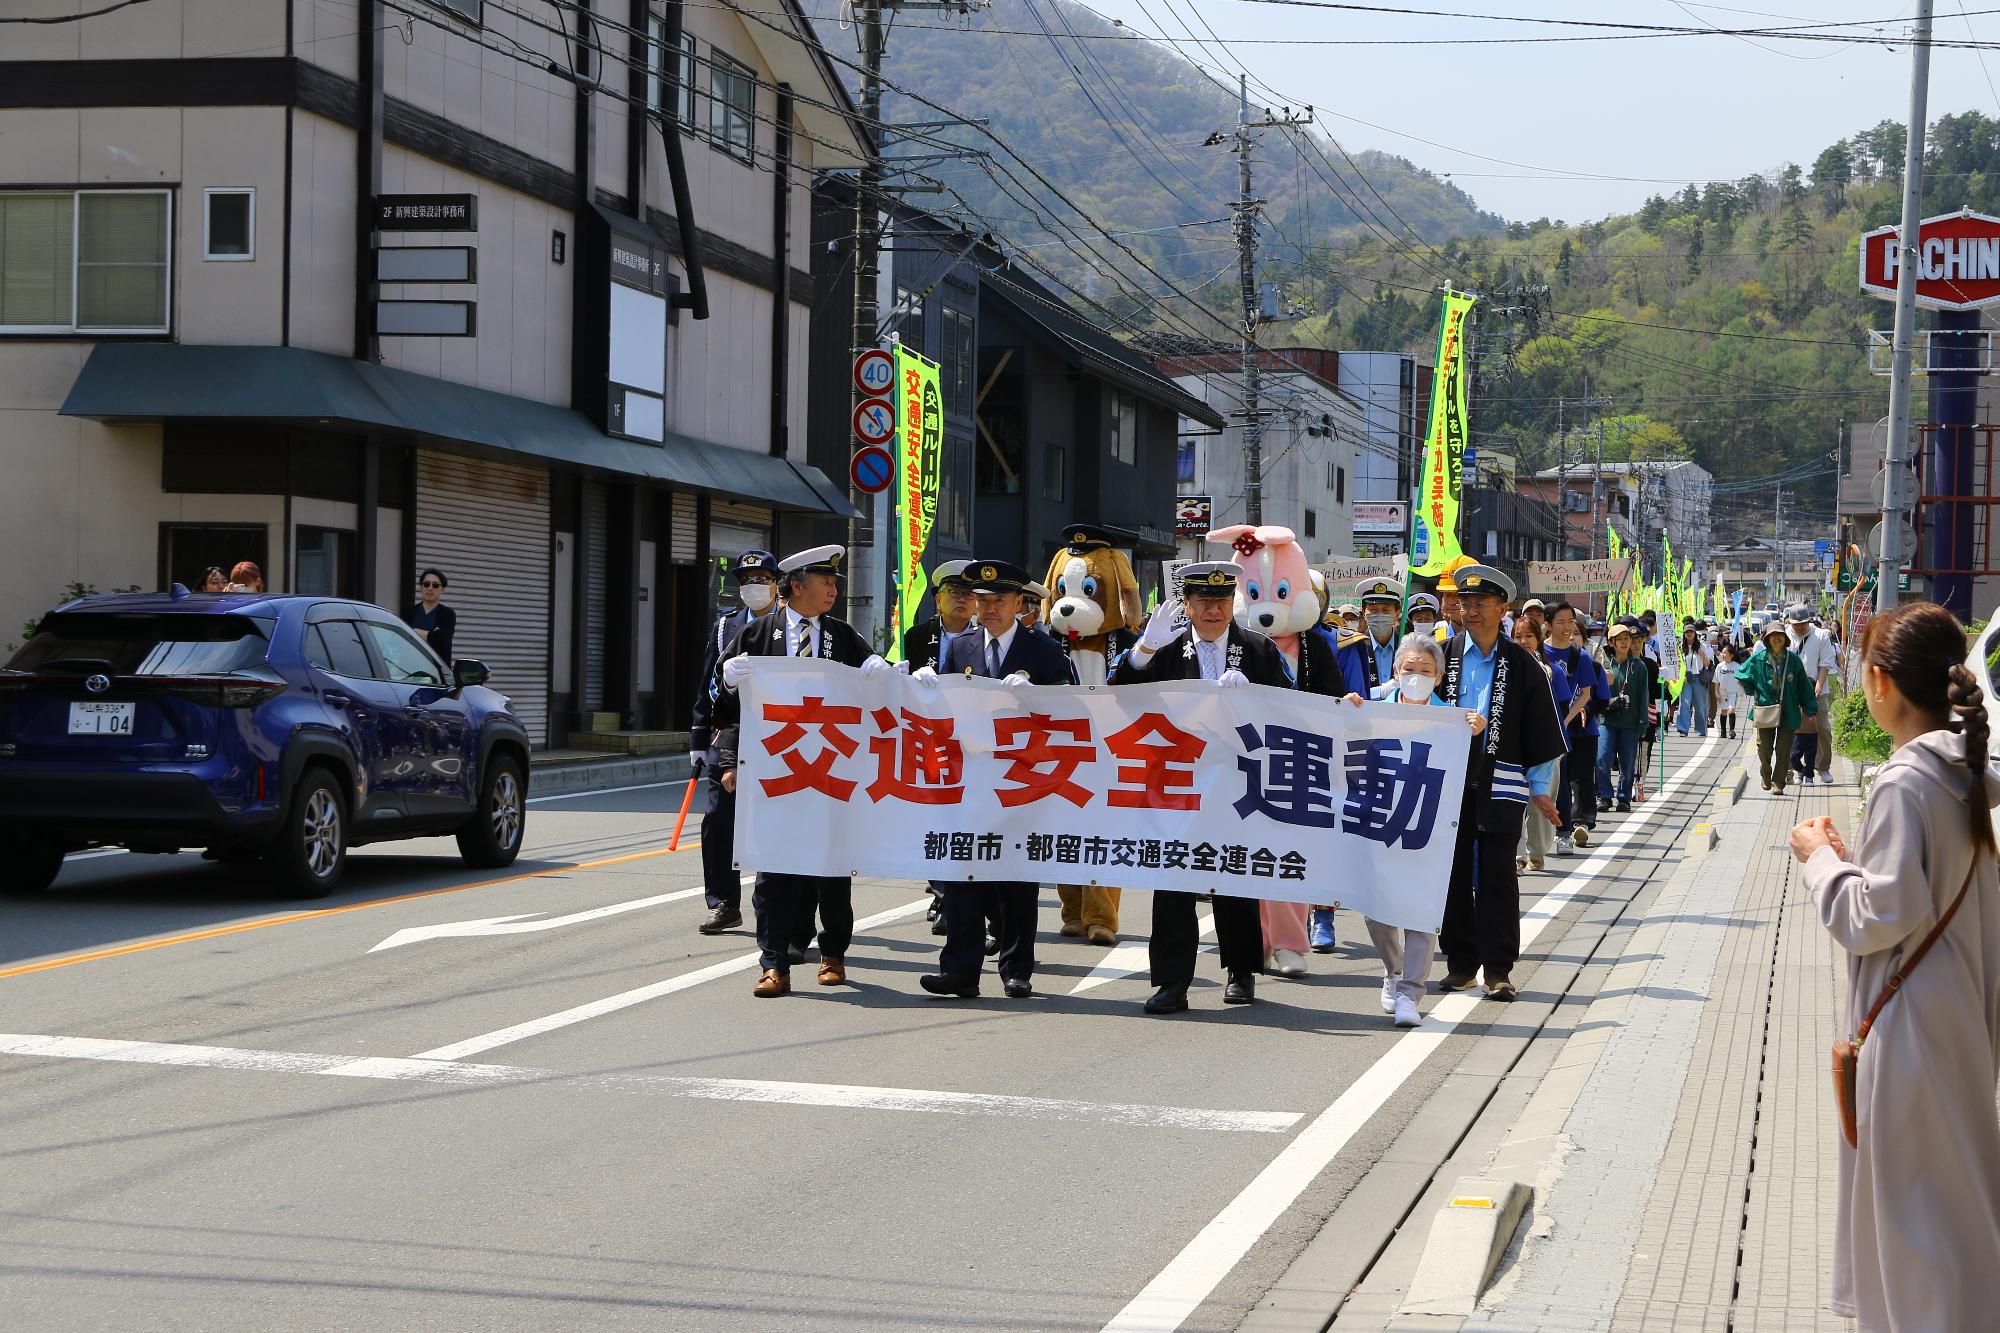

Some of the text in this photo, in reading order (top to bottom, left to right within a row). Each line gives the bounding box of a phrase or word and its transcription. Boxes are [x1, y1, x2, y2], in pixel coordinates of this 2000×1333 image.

[1883, 237, 2000, 281] PCHIN
[864, 363, 889, 384] 40
[1487, 656, 1509, 755] 大月交通安全協会
[758, 696, 1447, 850] 交通安全運動
